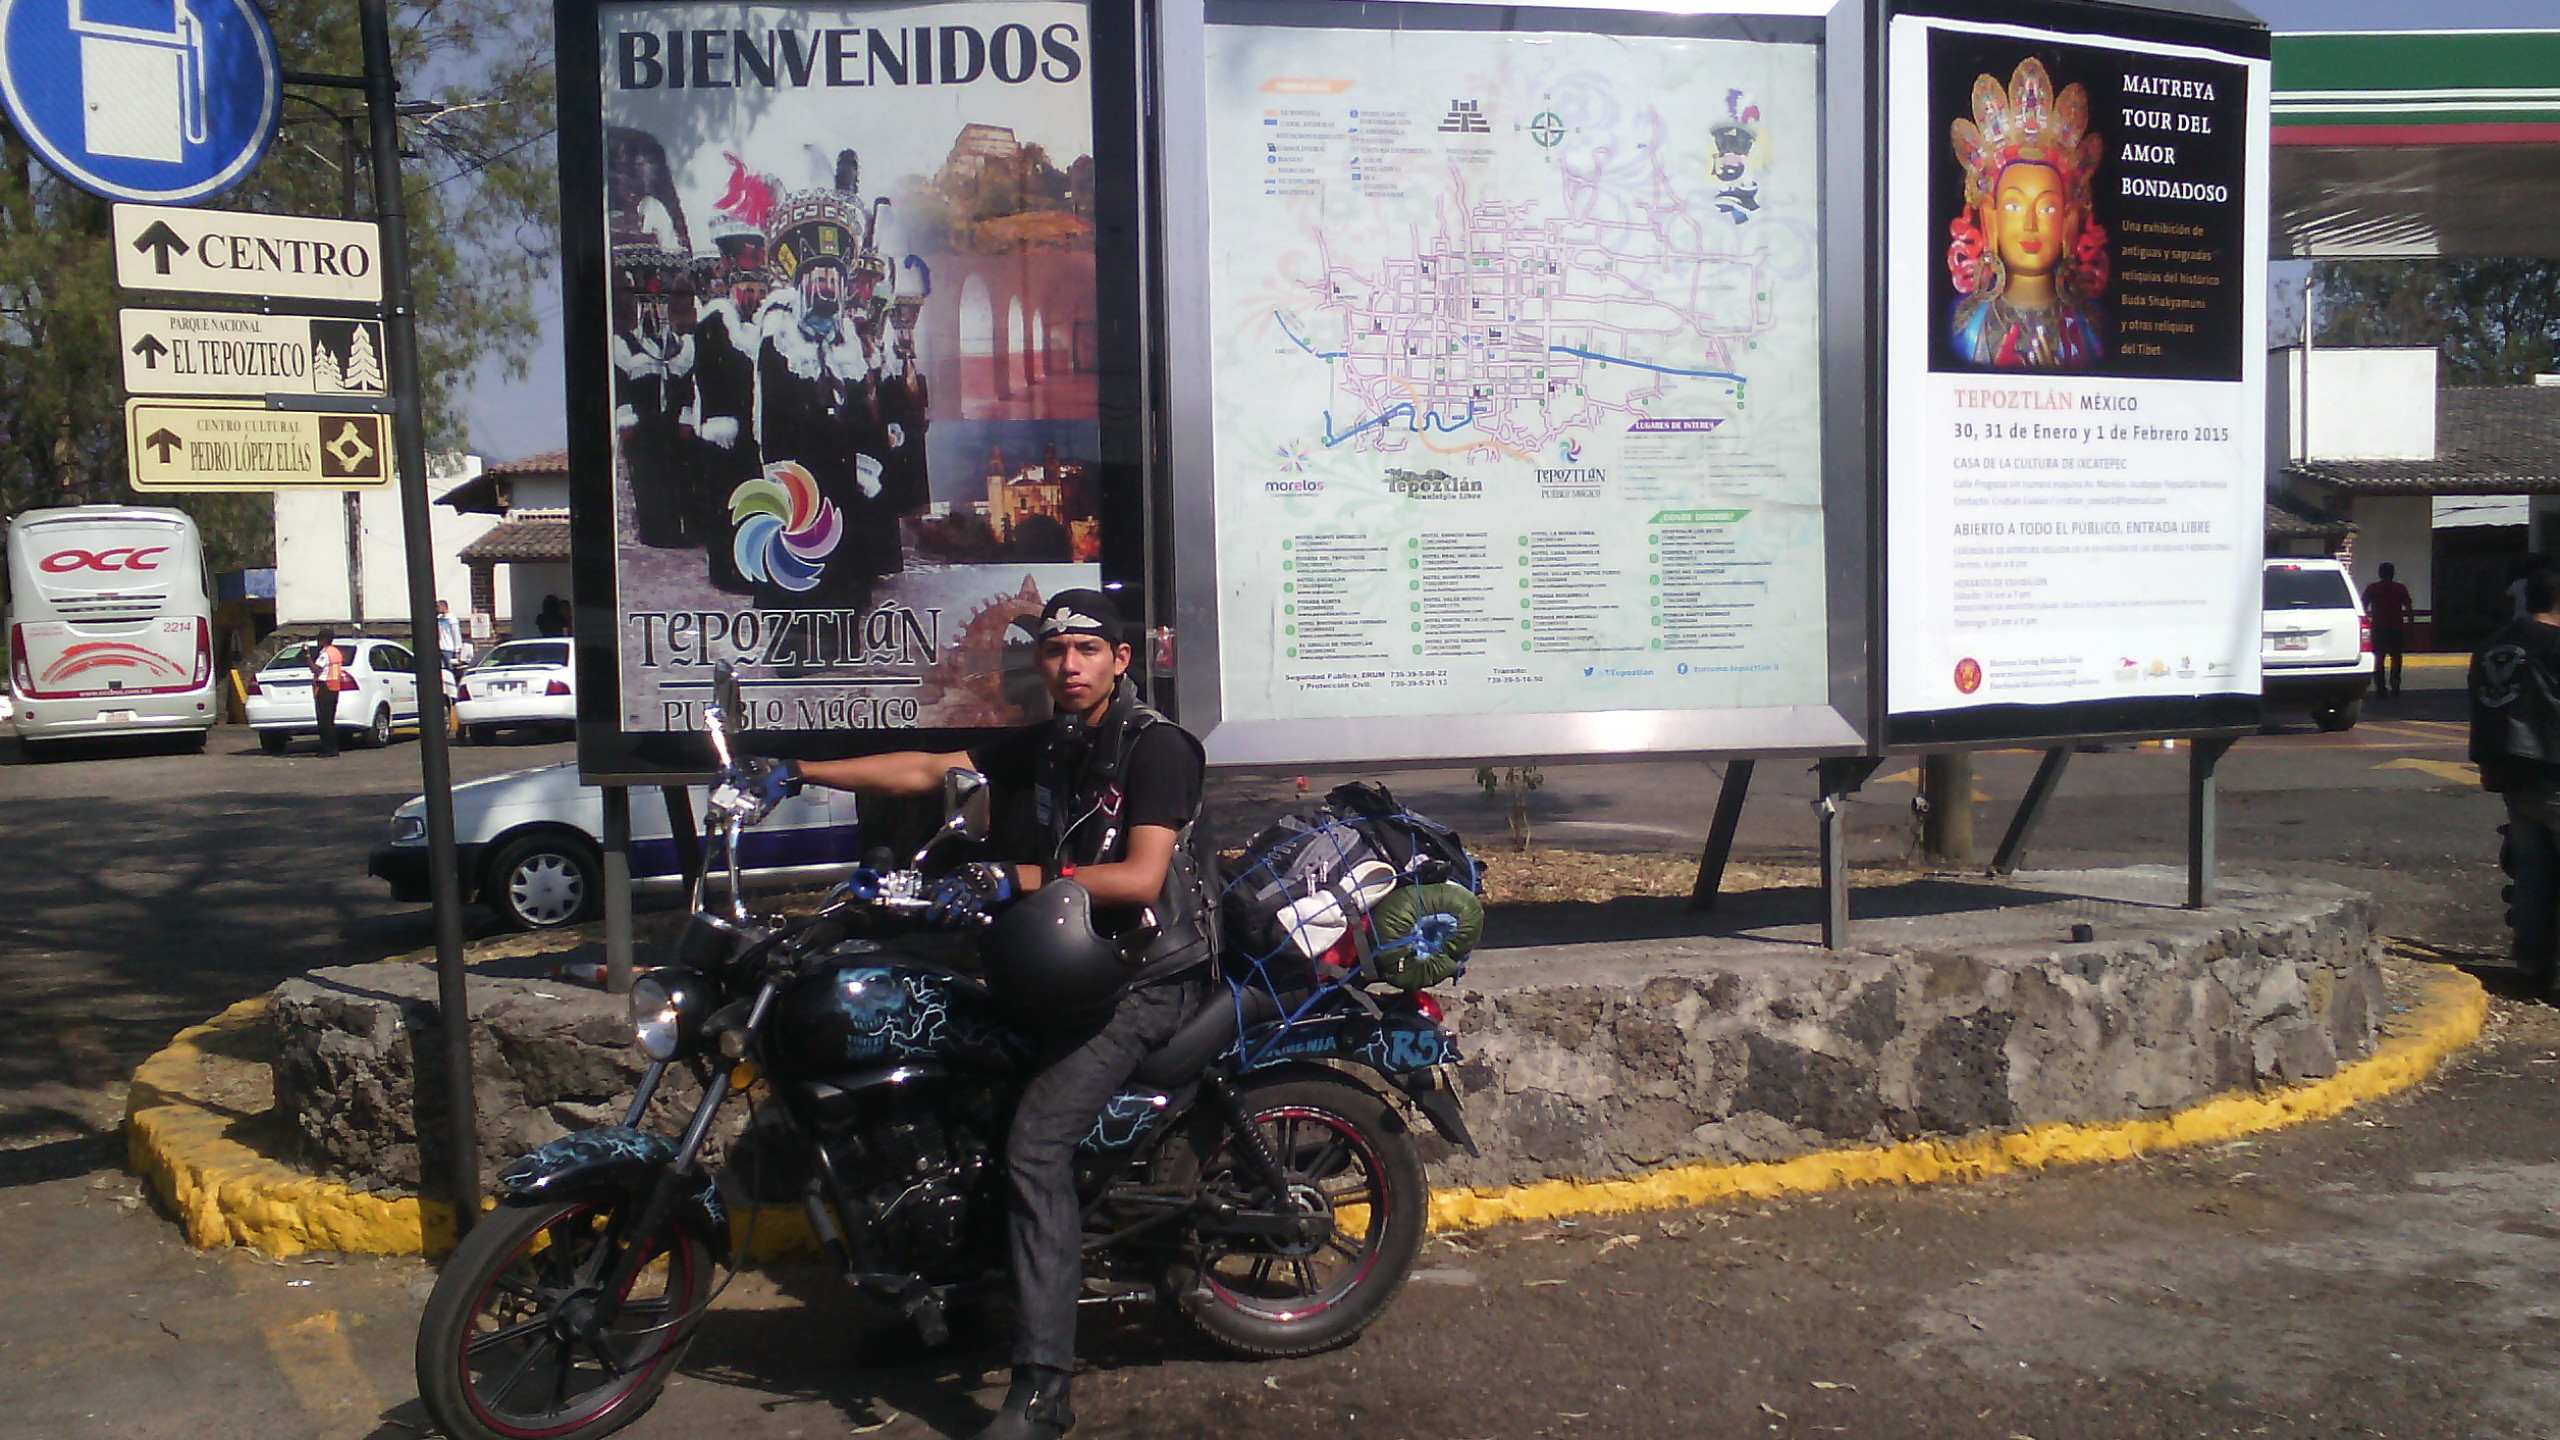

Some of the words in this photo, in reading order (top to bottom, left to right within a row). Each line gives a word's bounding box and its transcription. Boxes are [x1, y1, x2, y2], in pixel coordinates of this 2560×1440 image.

[618, 23, 1082, 90] BIENVENIDOS
[2123, 74, 2215, 101] MAITREYA
[2122, 109, 2172, 131] TOUR
[2178, 114, 2211, 134] DEL
[2121, 143, 2175, 165] AMOR
[2121, 178, 2228, 203] BONDADOSO
[2122, 220, 2140, 232] Una
[2143, 222, 2190, 235] exhibición
[2192, 225, 2204, 236] de
[197, 233, 370, 278] CENTRO
[2121, 246, 2161, 260] antiguas
[2163, 250, 2170, 259] y
[2172, 249, 2212, 262] sagradas
[2121, 270, 2161, 284] reliquias
[2163, 272, 2178, 283] del
[2121, 294, 2146, 305] Buda
[170, 316, 209, 331] PARQUE
[211, 318, 262, 333] NACIONAL
[2121, 322, 2127, 332] y
[2129, 320, 2152, 331] otras
[2155, 320, 2193, 335] reliquias
[172, 339, 196, 375] EL
[198, 340, 305, 377] TEPOZTECO
[2121, 344, 2136, 354] del
[1954, 386, 2072, 410] TEPOZTLÁN
[2080, 392, 2138, 411] MÉXICO
[197, 419, 241, 432] CENTRO
[244, 420, 302, 433] CULTURAL
[1954, 423, 1979, 440] 30,
[1985, 423, 2002, 439] 31
[2009, 423, 2027, 439] de
[2034, 424, 2077, 440] Enero
[2083, 427, 2091, 444] y
[2097, 425, 2104, 440] 1
[2110, 425, 2128, 440] de
[2134, 425, 2188, 441] Febrero
[2195, 427, 2230, 442] 2015
[190, 441, 231, 472] PEDRO
[235, 433, 273, 473] LÓPEZ
[276, 435, 313, 473] ELÍAS
[1953, 457, 1980, 470] CASA
[1983, 457, 1995, 470] DE
[2000, 457, 2011, 470] LA
[2014, 457, 2059, 470] CULTURA
[2062, 457, 2073, 470] DE
[1265, 479, 1324, 491] morelos
[1385, 469, 1483, 498] Tepoztlán
[1953, 522, 2004, 537] ABIERTO
[2008, 522, 2016, 536] A
[2020, 521, 2052, 536] TODO
[2056, 521, 2068, 536] EL
[2126, 520, 2178, 535] ENTRADA
[2181, 520, 2211, 534] LIBRE
[39, 547, 170, 573] OCC
[163, 622, 191, 633] 2214
[1285, 673, 1325, 682] Seguridad
[1391, 1029, 1439, 1068] R5
